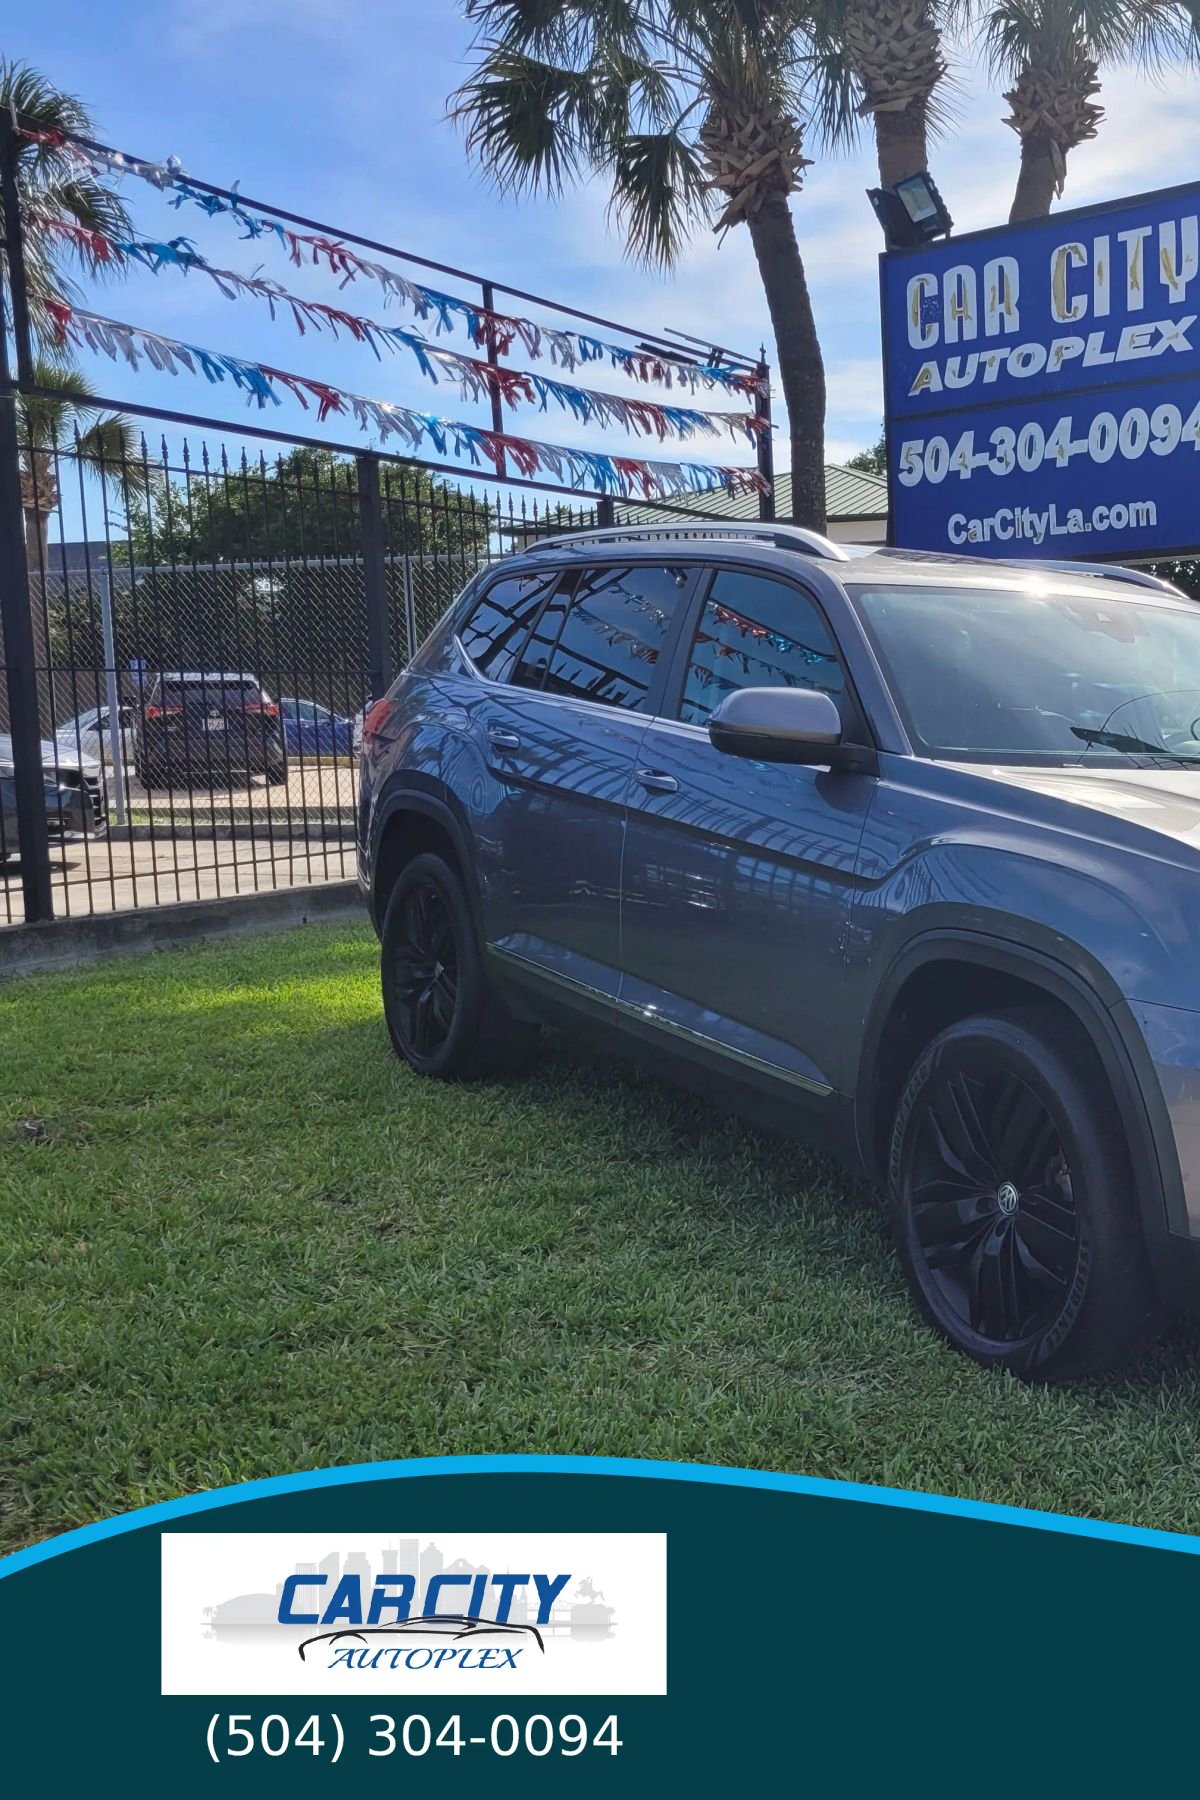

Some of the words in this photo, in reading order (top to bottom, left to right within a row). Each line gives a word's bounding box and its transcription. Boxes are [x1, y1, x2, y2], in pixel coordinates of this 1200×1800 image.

[906, 255, 1020, 350] CAR
[1050, 215, 1199, 324] CITY
[907, 315, 1198, 396] AUTOPLEX
[948, 500, 1157, 545] CarCityLa.com
